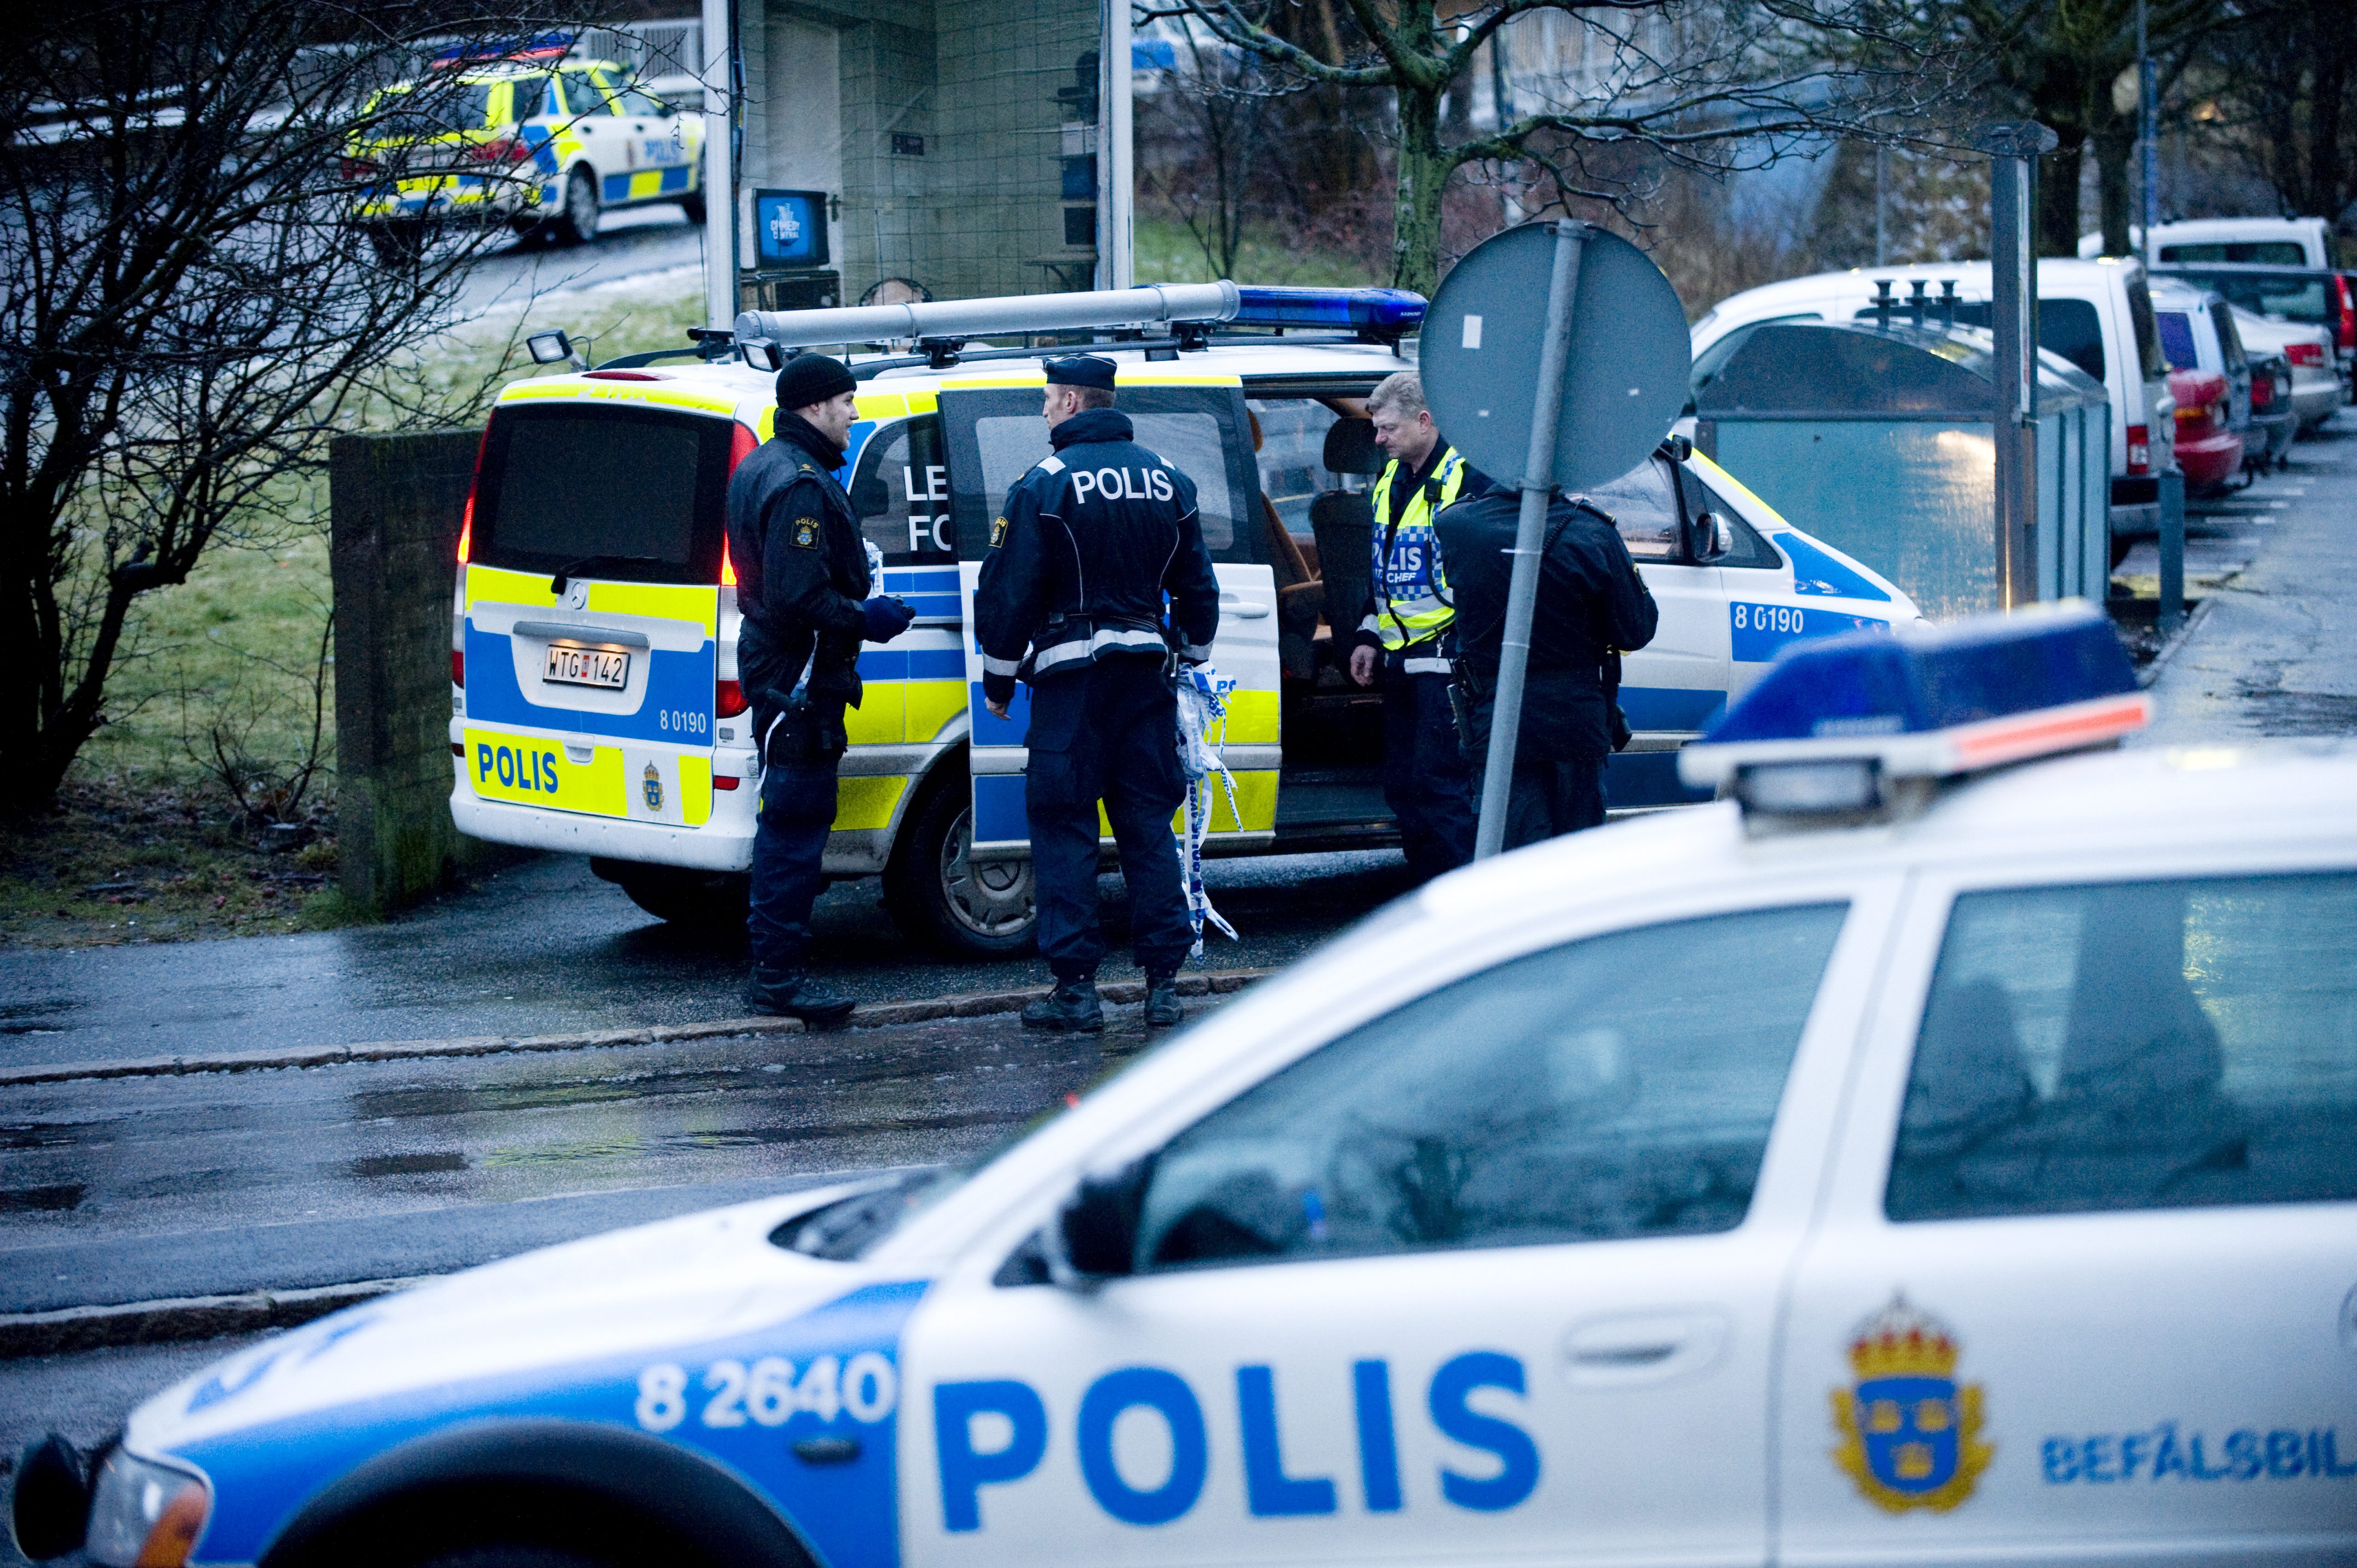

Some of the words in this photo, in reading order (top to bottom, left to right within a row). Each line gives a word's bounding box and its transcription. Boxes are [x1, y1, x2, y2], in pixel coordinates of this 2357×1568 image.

[1071, 467, 1173, 504] POLIS
[795, 518, 818, 528] POLIS
[1387, 573, 1417, 583] CHEF
[1735, 605, 1747, 629] 8
[1754, 606, 1804, 634] 0190
[549, 650, 579, 677] WTG
[594, 655, 622, 683] 142
[660, 709, 668, 730] 8
[673, 710, 706, 734] 0190
[478, 743, 558, 793] POLIS
[634, 1362, 688, 1432] 8
[701, 1352, 898, 1428] 2640
[934, 1349, 1542, 1534] POLIS
